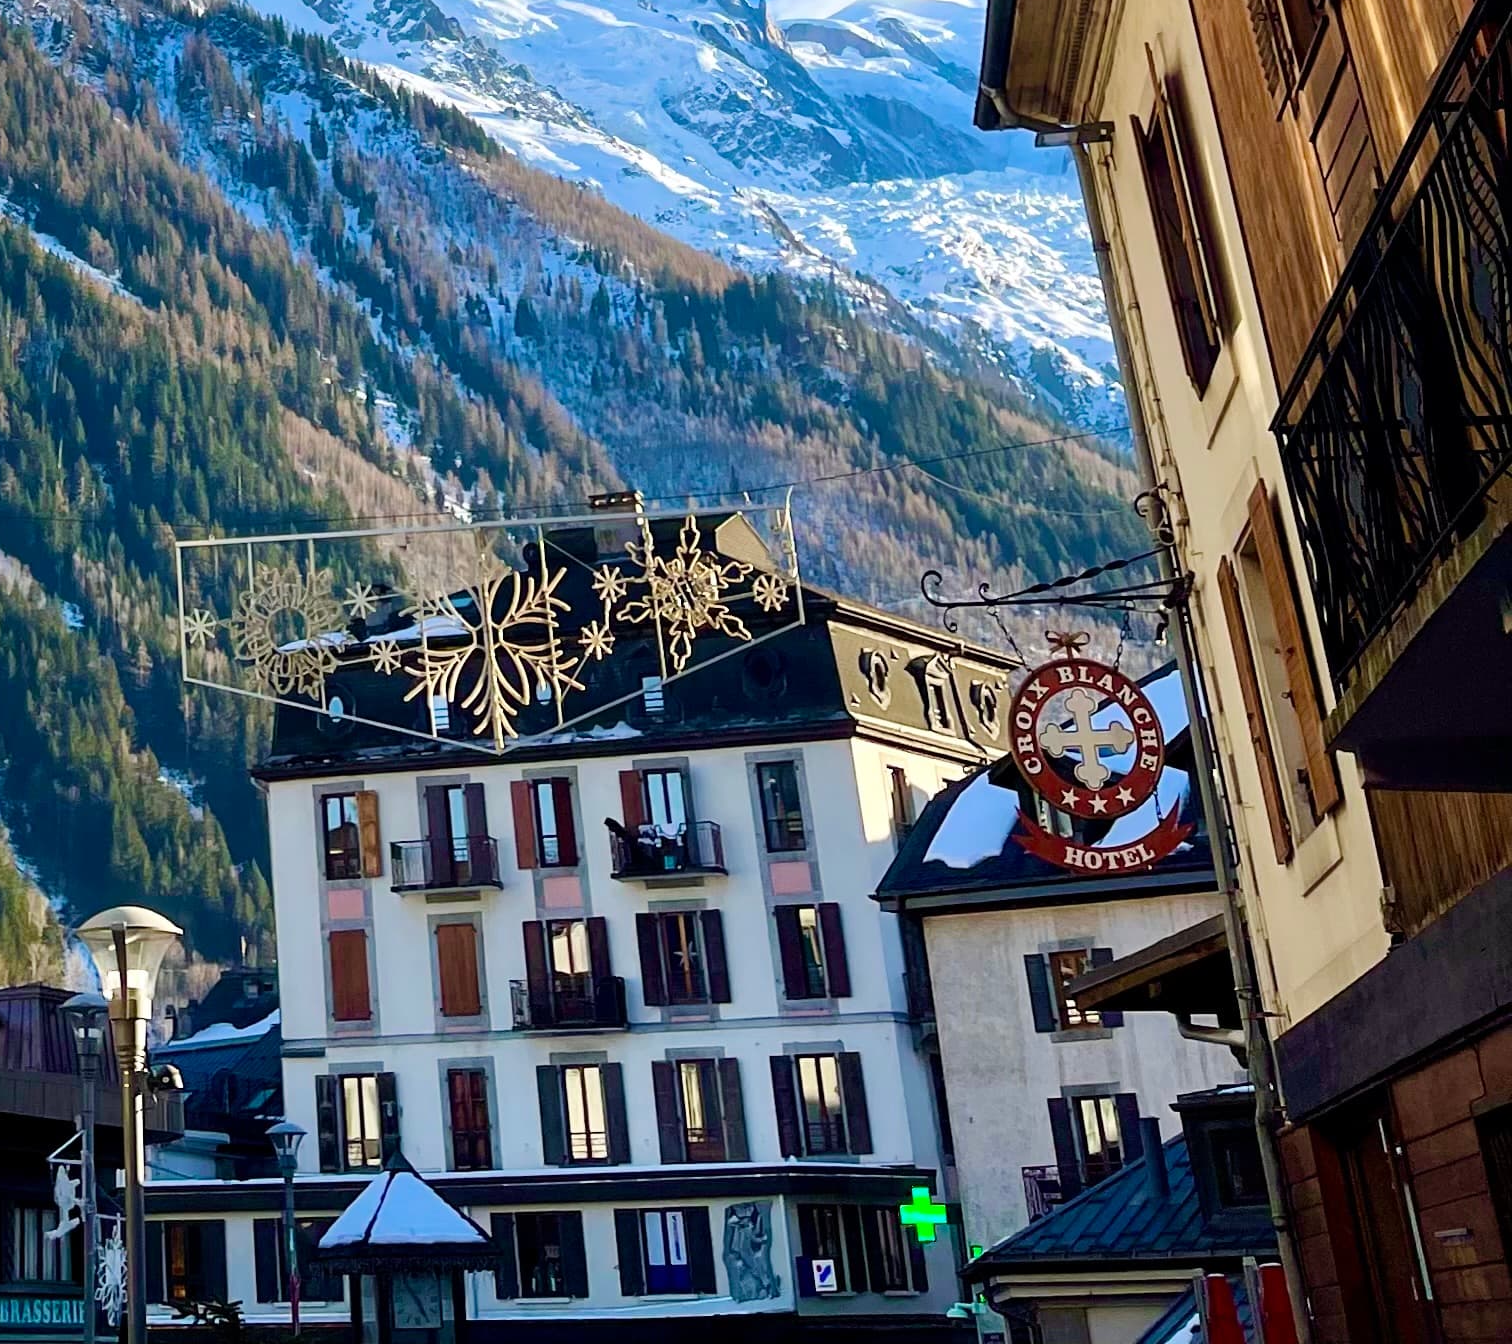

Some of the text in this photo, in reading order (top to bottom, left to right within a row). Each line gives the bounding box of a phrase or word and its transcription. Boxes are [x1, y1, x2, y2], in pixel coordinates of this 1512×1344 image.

[1015, 665, 1159, 776] CROIX BLANCHE
[1063, 841, 1156, 871] HOTEL
